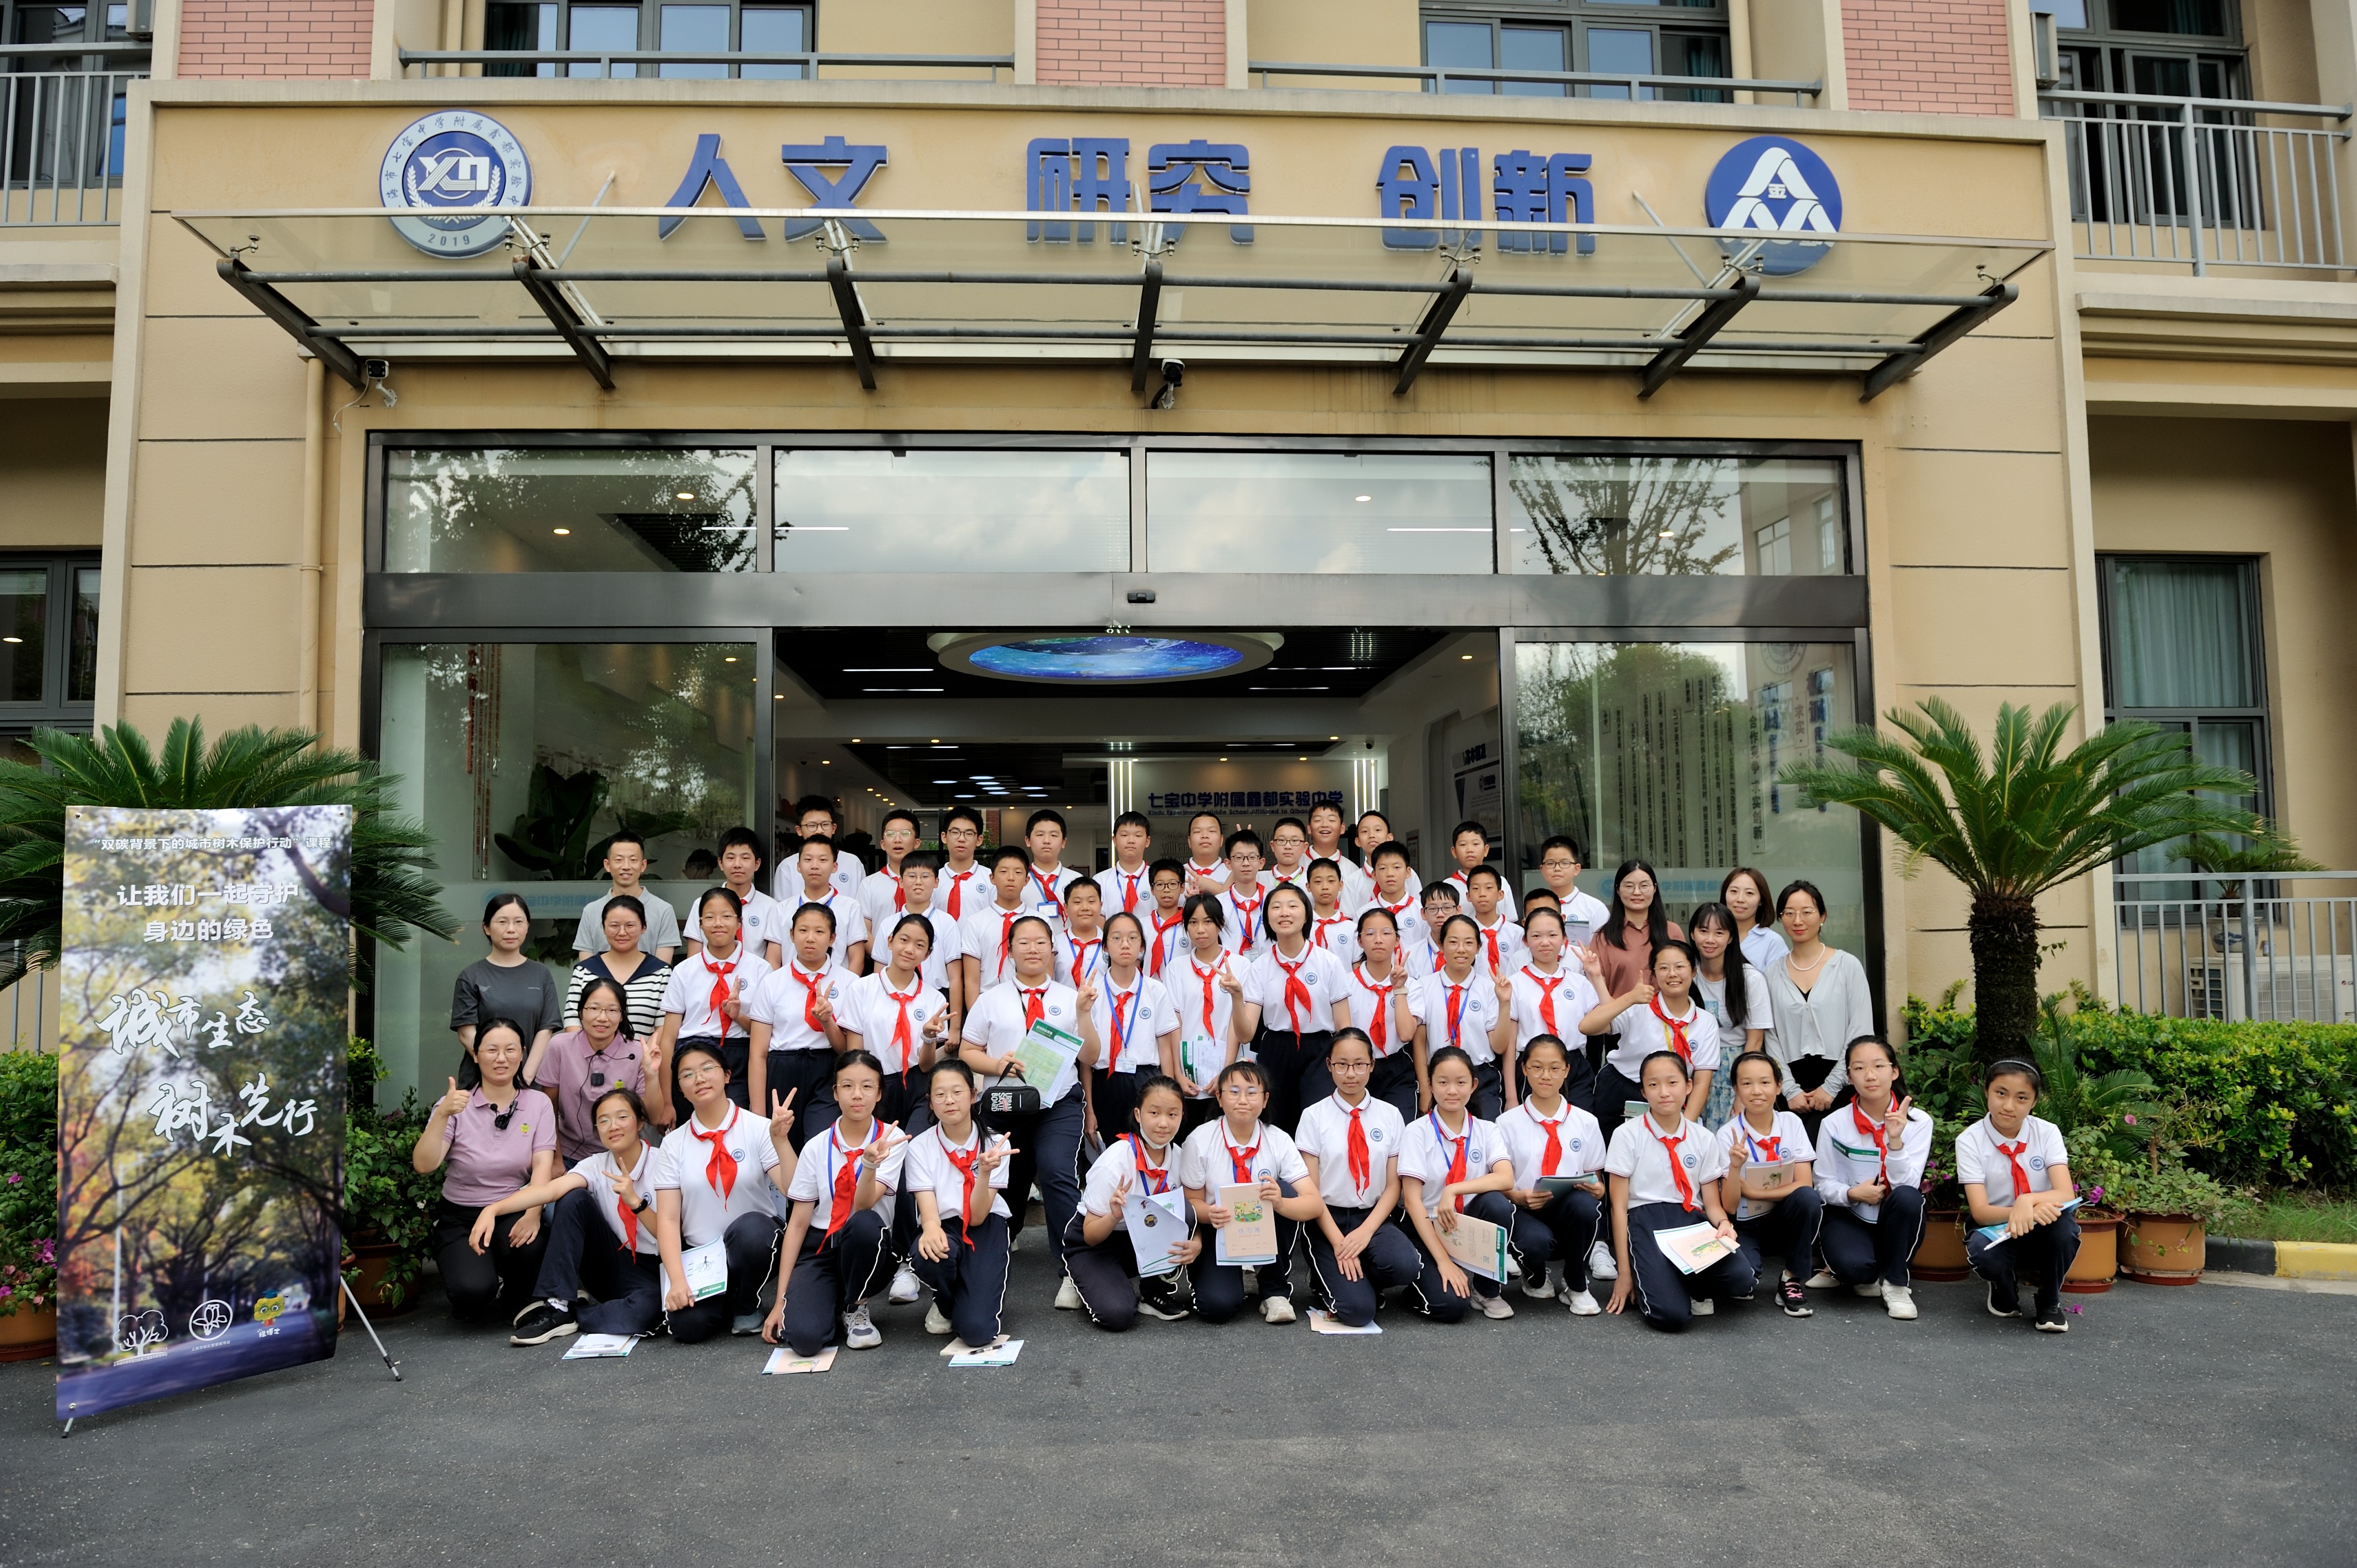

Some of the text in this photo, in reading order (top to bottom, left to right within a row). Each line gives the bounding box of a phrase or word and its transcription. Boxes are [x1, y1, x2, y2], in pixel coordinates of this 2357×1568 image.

[659, 134, 1596, 256] 人文 研究 创新
[428, 233, 471, 246] 2019
[1148, 791, 1343, 808] 七宝中学附属鑫都实验中学
[1751, 780, 1763, 841] 求实创新
[94, 837, 331, 851] “双碳背景下的城市树木保护行动” 课程
[117, 883, 299, 907] 让我们一起守护
[143, 918, 274, 943] 身边的绿色
[95, 988, 270, 1059] 城市生态
[148, 1072, 318, 1157] 树木先行
